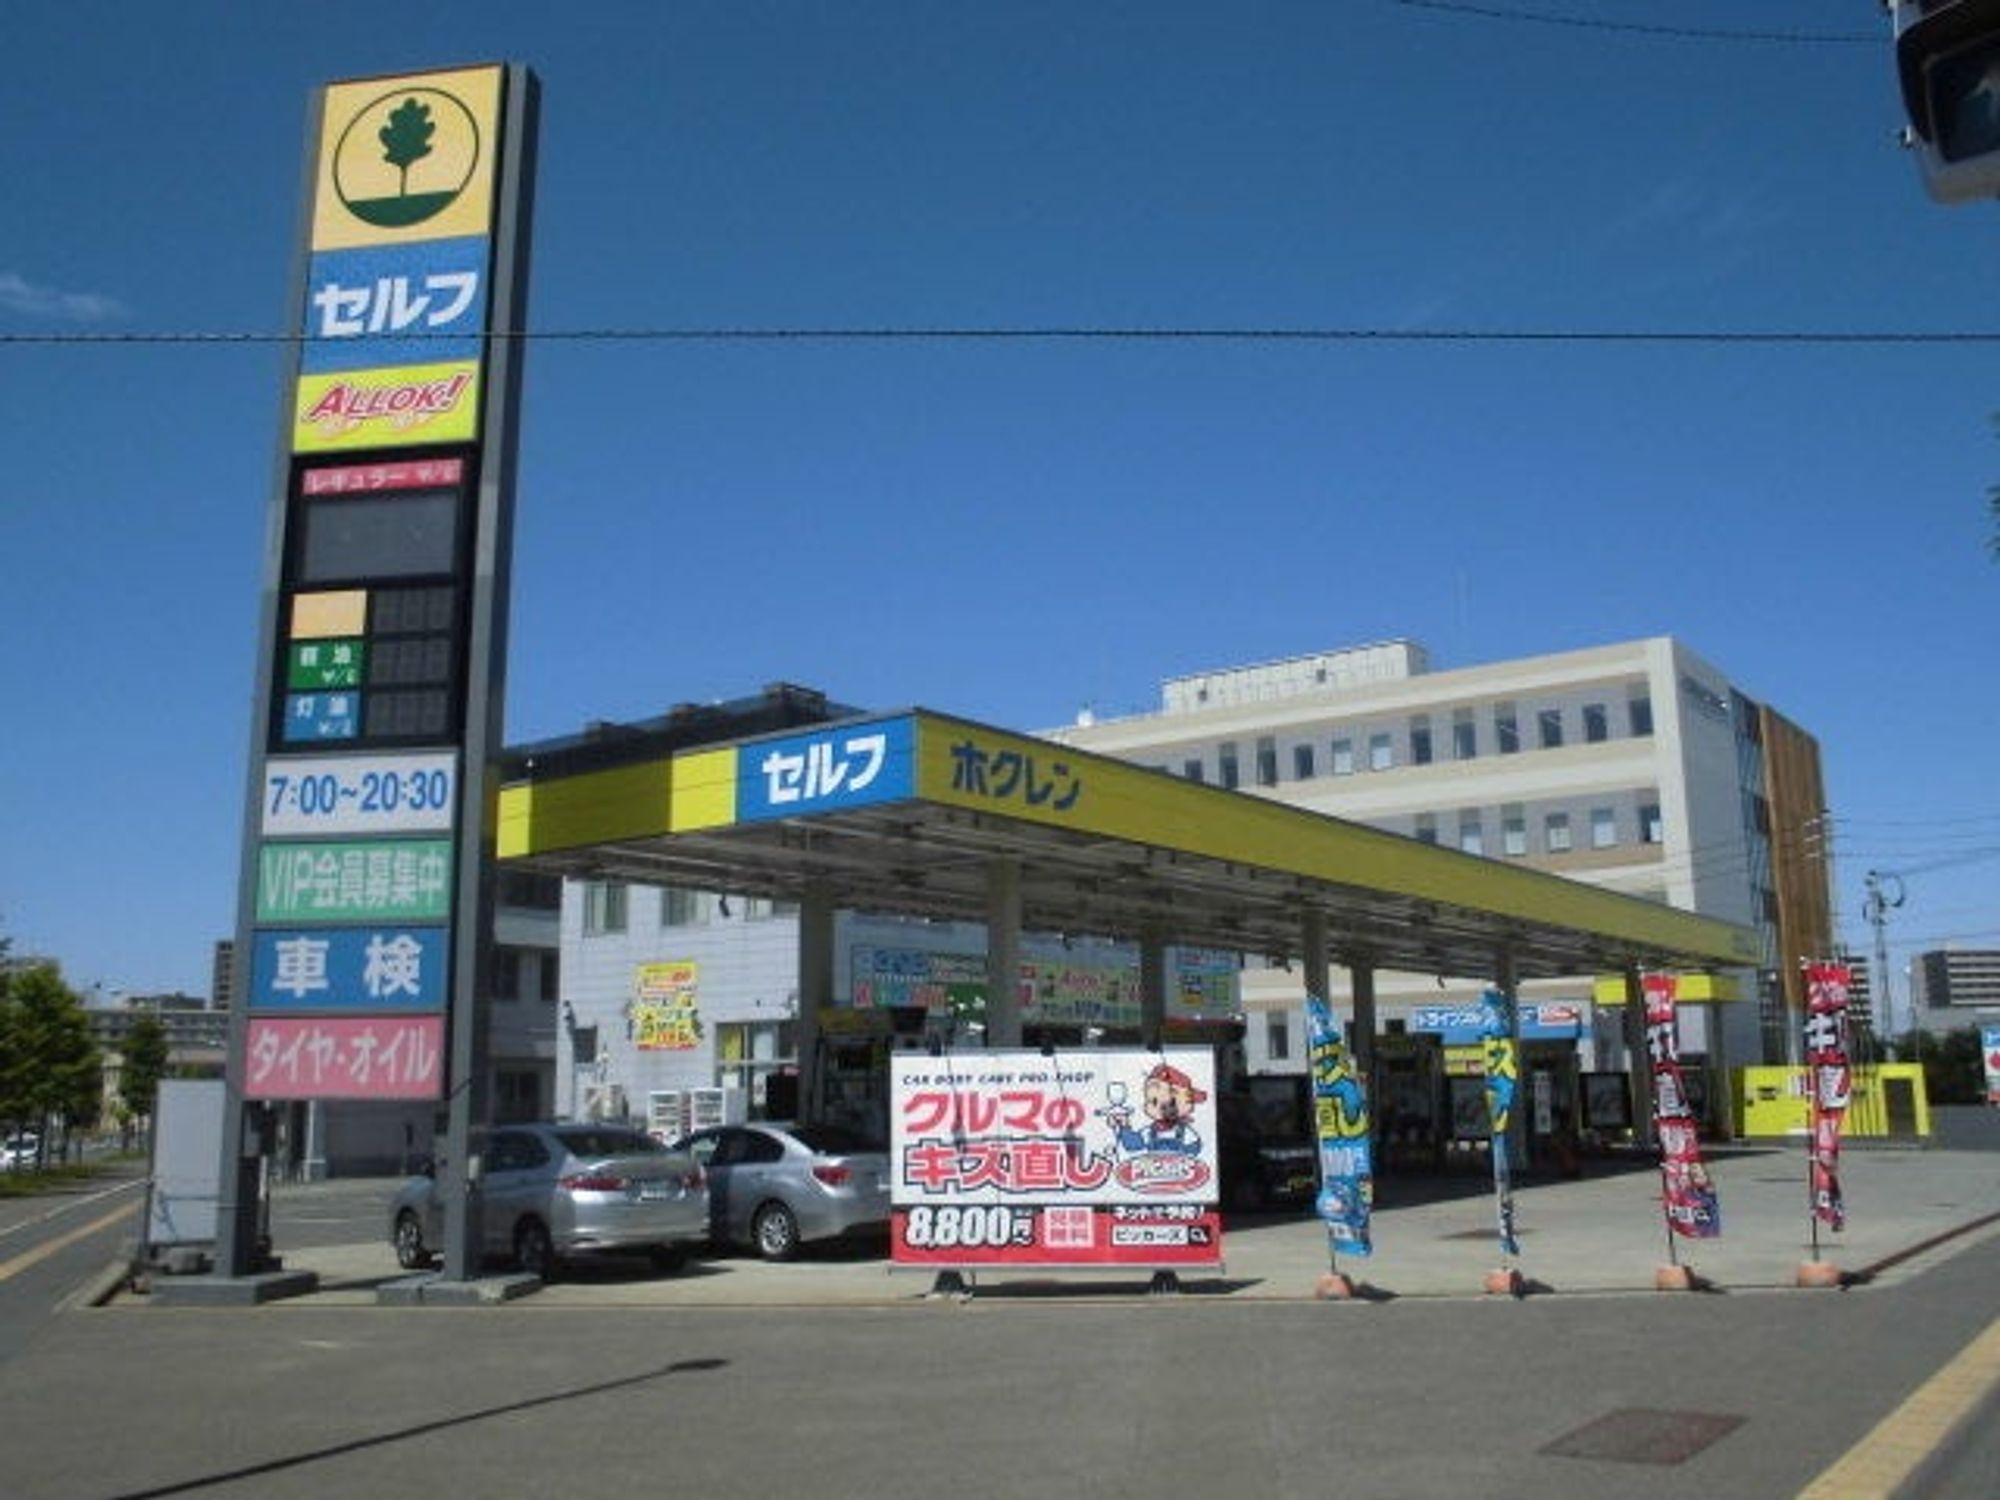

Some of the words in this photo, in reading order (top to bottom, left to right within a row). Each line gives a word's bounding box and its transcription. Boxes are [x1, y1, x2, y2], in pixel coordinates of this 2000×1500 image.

[313, 271, 478, 337] セルフ
[307, 374, 470, 422] ALLOK!
[762, 734, 886, 805] セルフ
[950, 740, 1081, 811] ホクレン
[263, 849, 443, 914] VIP会員募集中
[272, 934, 424, 997] 車検
[903, 1091, 1086, 1133] クルマの
[904, 1137, 1112, 1193] キズ直し
